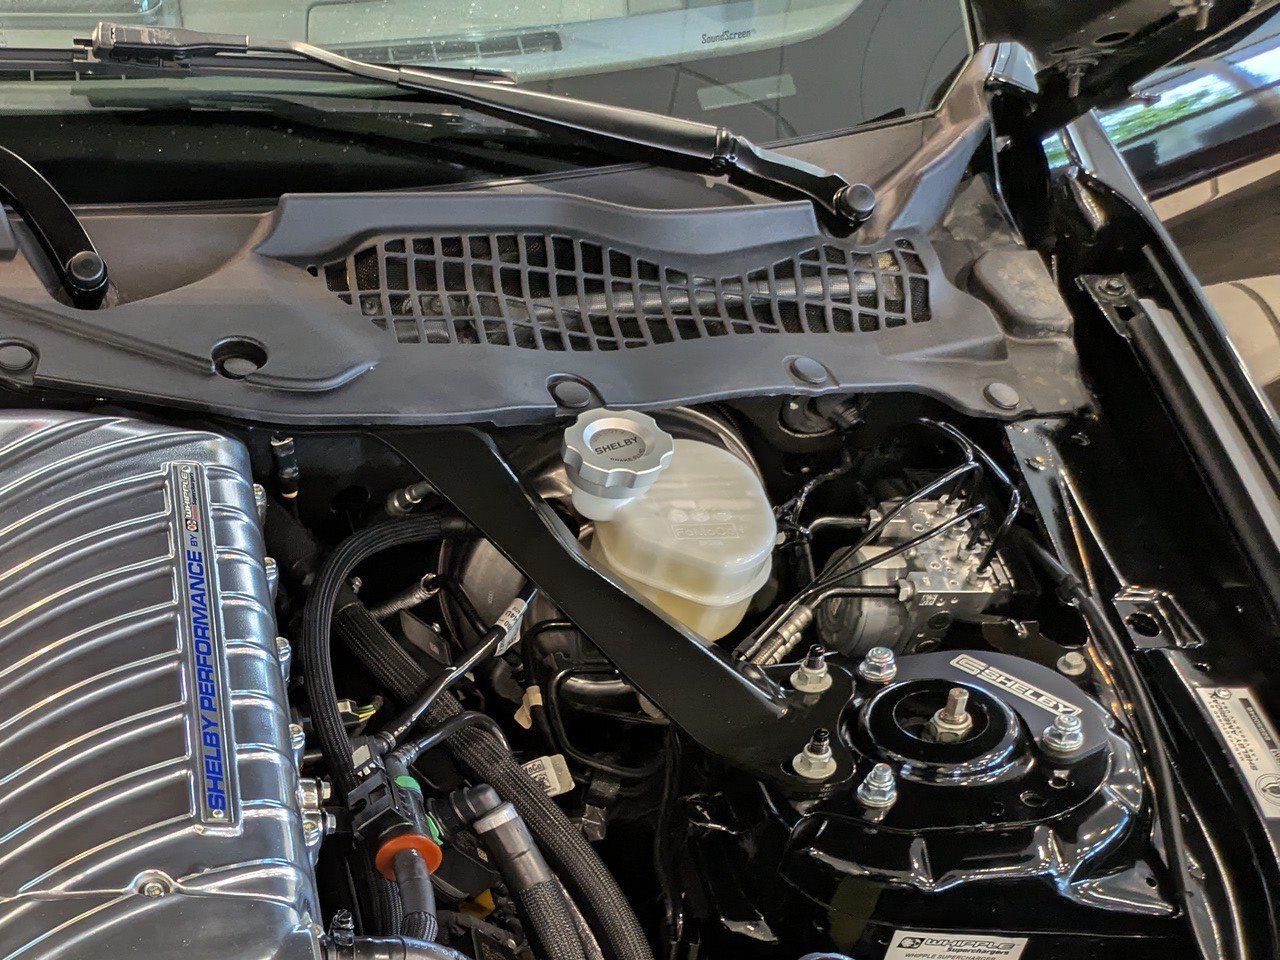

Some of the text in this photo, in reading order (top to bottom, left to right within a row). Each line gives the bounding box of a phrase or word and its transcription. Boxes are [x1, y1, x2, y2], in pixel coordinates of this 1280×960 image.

[701, 30, 752, 44] SoundScreen
[594, 436, 639, 456] SHELBY
[181, 472, 192, 518] WHIPPLE
[186, 534, 228, 812] SHELBY PERFORMANCE BY
[982, 667, 1074, 716] SHELBY
[1235, 737, 1258, 771] SHELBY
[925, 938, 1016, 950] WHIPPLE
[946, 946, 1010, 955] Superchargers
